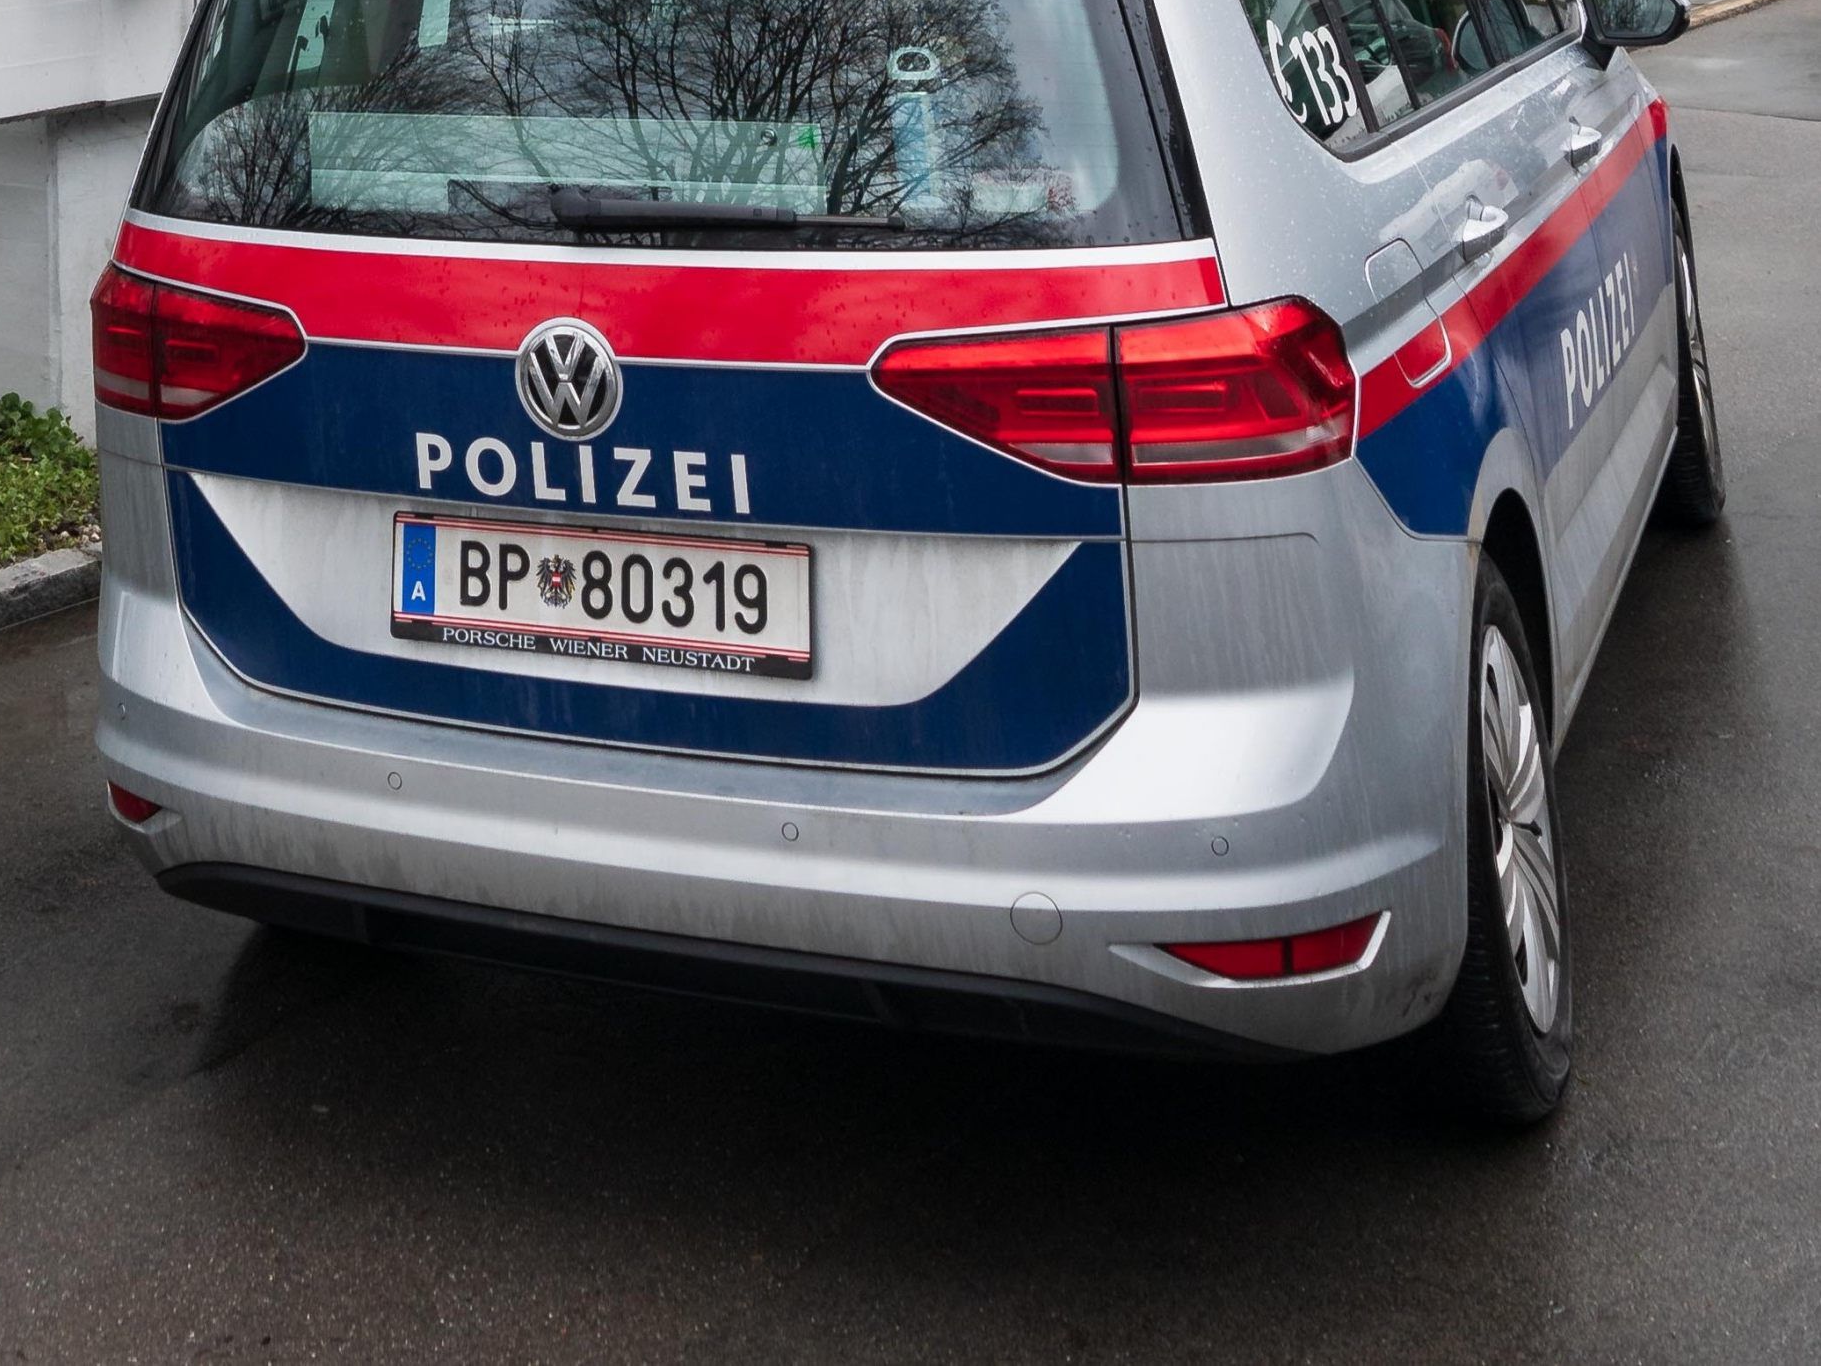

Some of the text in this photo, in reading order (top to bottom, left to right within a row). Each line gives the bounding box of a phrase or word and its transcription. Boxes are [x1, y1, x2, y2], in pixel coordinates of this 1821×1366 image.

[1289, 26, 1358, 126] 133
[520, 322, 618, 436] VW
[1560, 251, 1636, 430] POLIZEI
[415, 432, 751, 515] POLIZEI
[410, 579, 427, 602] A
[459, 539, 769, 635] BP 80319
[442, 626, 756, 673] PORSCHE WIENER NEUSTADT
